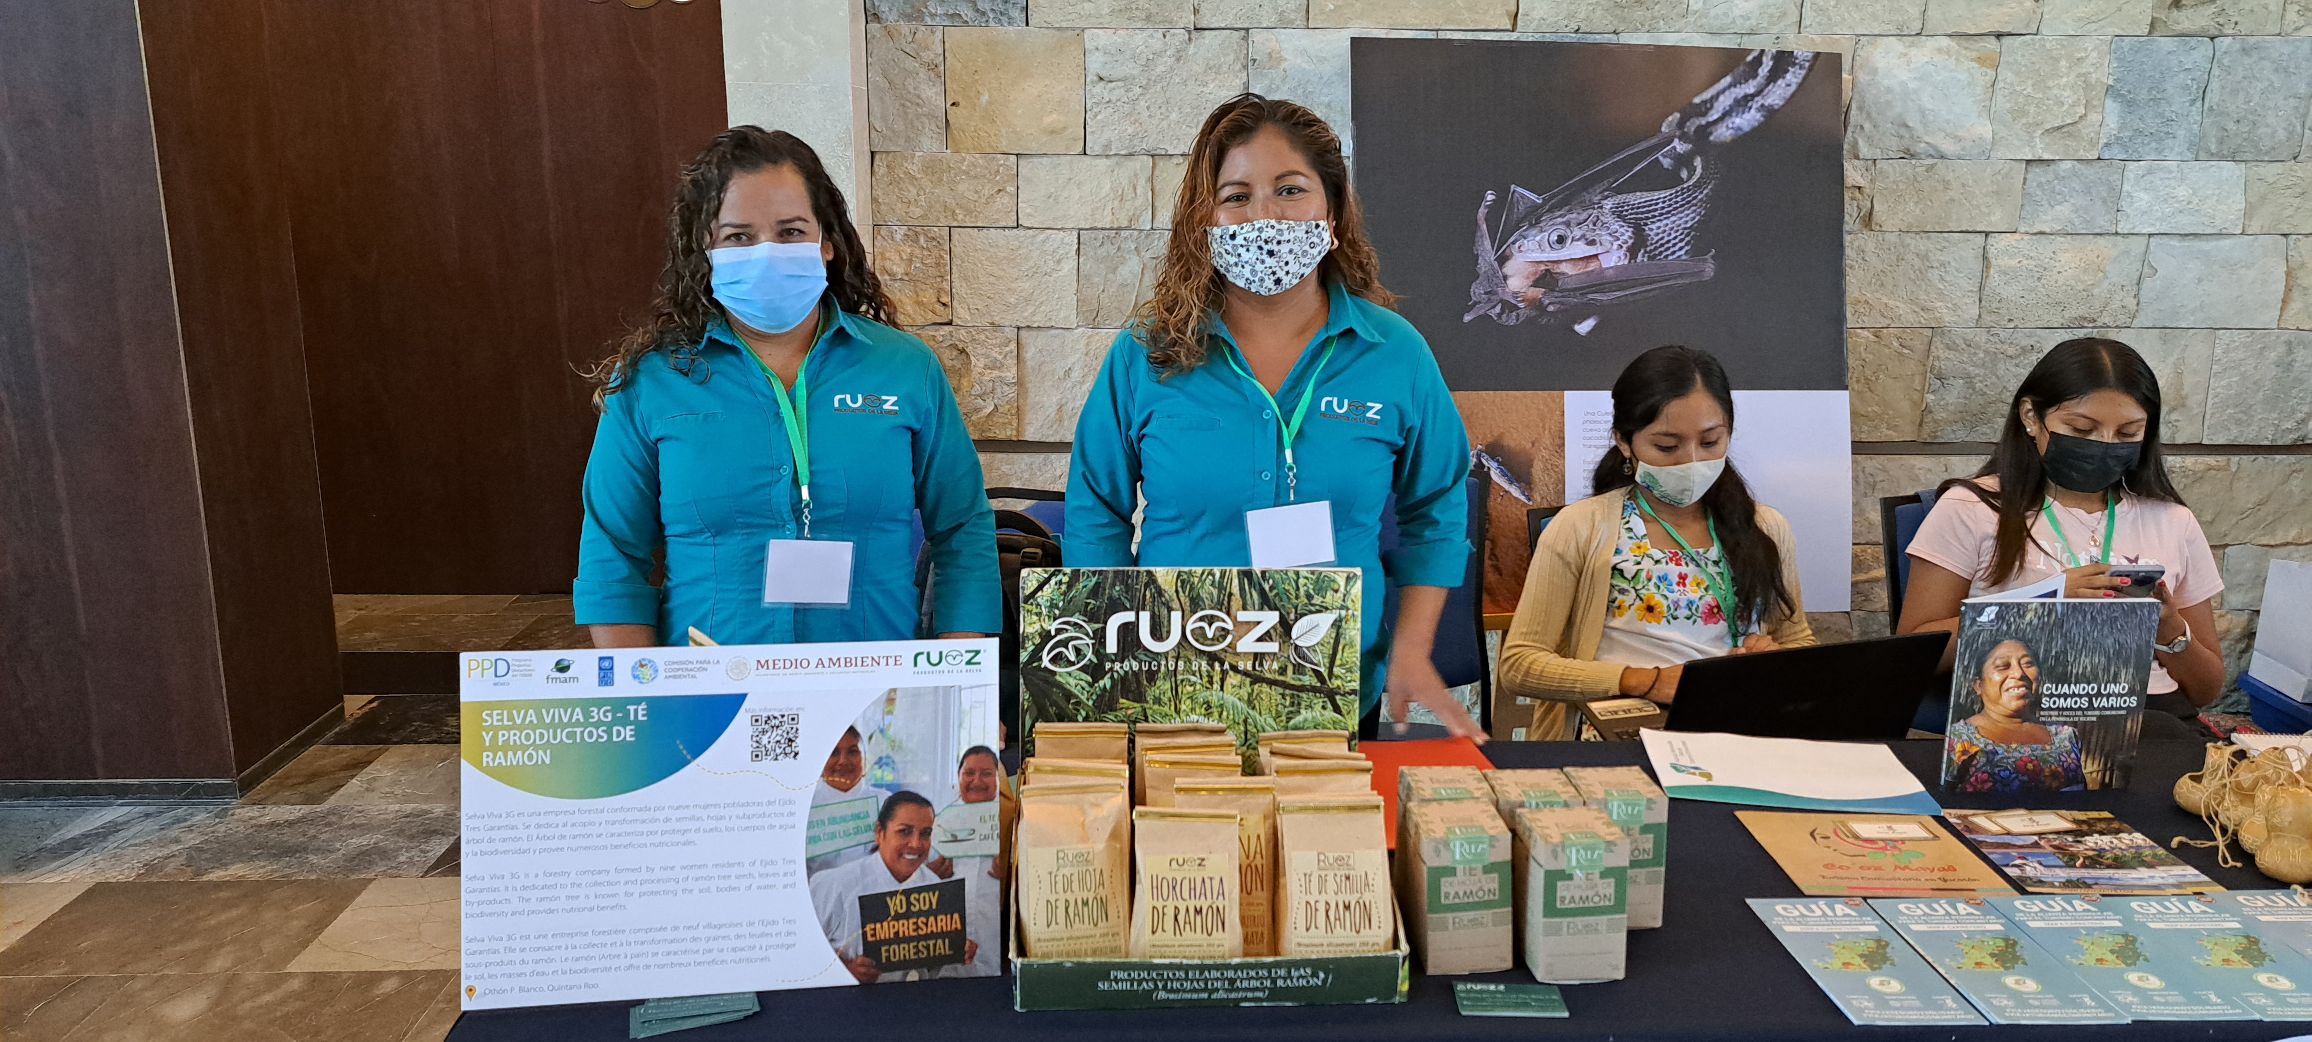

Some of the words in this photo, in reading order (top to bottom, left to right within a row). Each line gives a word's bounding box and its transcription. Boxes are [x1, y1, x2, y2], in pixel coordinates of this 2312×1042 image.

[468, 658, 510, 678] PPD
[756, 658, 810, 671] MEDIO
[815, 655, 902, 668] AMBIENTE
[1105, 661, 1184, 671] PRODUCTOS
[1192, 661, 1206, 670] DE
[1216, 661, 1230, 670] LA
[1238, 661, 1278, 670] SELVA
[546, 675, 579, 684] fmam
[2043, 684, 2098, 694] CUANDO
[2100, 683, 2128, 694] UNO
[2040, 696, 2088, 708] SOMOS
[2092, 696, 2138, 708] VARIOS
[482, 708, 538, 726] SELVA
[542, 707, 584, 724] VIVA
[588, 706, 612, 722] 3G
[626, 702, 648, 721] TÉ
[482, 730, 494, 746] Y
[498, 726, 608, 746] PRODUCTOS
[612, 725, 636, 742] DE
[482, 748, 550, 767] RAMÓN
[1049, 866, 1060, 894] TÉ
[1062, 873, 1074, 894] DE
[1078, 868, 1105, 894] HOJA
[1151, 874, 1226, 902] HORCHATA
[1304, 871, 1312, 896] TÉ
[1318, 874, 1328, 896] DE
[1333, 870, 1370, 898] SEMILLA
[886, 894, 907, 913] YO
[910, 892, 938, 911] SOY
[1444, 886, 1497, 902] RAMÓN
[1558, 892, 1612, 906] RAMÓN
[1046, 898, 1060, 928] DE
[1064, 892, 1108, 929] RAMÓN
[1776, 901, 1858, 916] GUÍA
[1898, 900, 1981, 916] GUÍA
[2014, 898, 2098, 912] GUÍA
[2130, 899, 2216, 914] GUÍA
[1152, 905, 1168, 935] DE
[1174, 901, 1226, 937] RAMÓN
[1305, 900, 1320, 932] DE
[1325, 897, 1372, 934] RAMÓN
[866, 913, 961, 942] EMPRESARIA
[881, 938, 953, 964] FORESTAL
[1098, 980, 1154, 990] SEMILLAS
[1156, 981, 1165, 990] Y
[1168, 980, 1205, 990] HOJAS
[1208, 980, 1232, 989] DEL
[1234, 977, 1274, 988] ÁRBOL
[1277, 975, 1322, 988] RAMÓN
[1110, 970, 1186, 980] PRODUCTOS
[1188, 968, 1269, 980] ELABORADOS
[1272, 968, 1288, 978] DE
[1291, 968, 1312, 977] LAS
